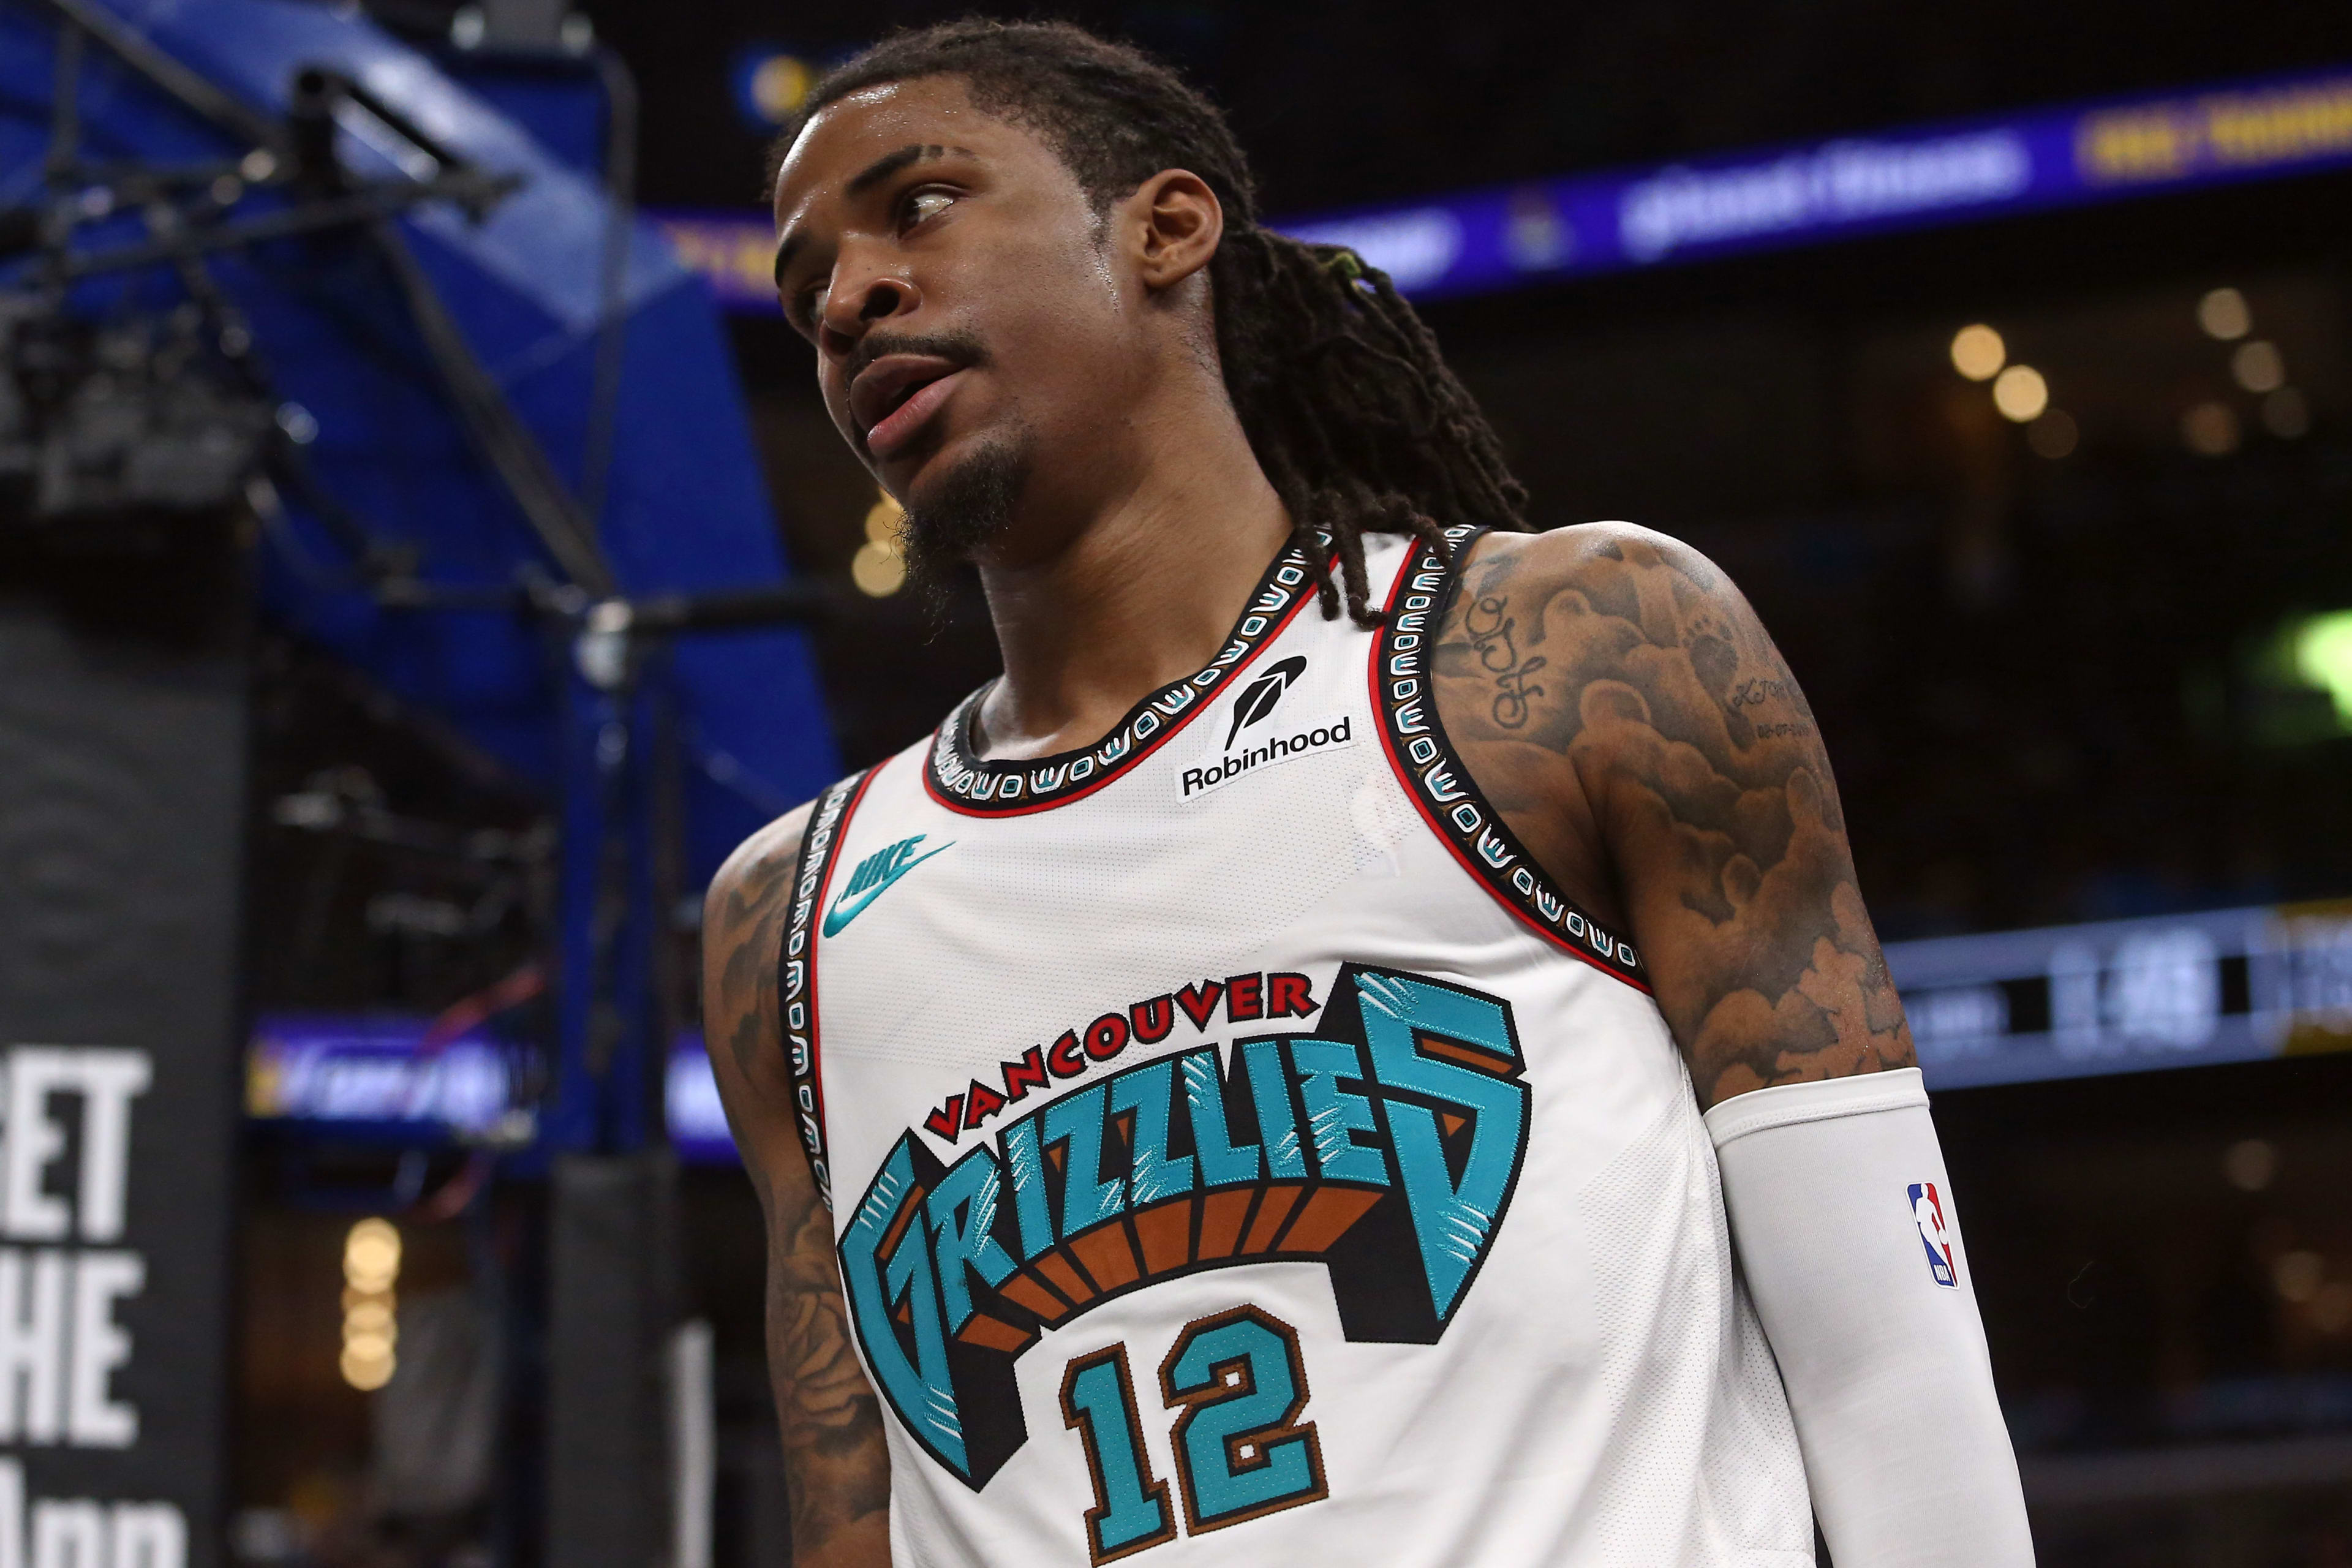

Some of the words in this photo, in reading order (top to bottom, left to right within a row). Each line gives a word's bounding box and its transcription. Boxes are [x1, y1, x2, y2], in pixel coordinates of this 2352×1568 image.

[1182, 716, 1351, 796] Robinhood
[839, 834, 927, 903] NIKE
[0, 1044, 154, 1245] ET
[924, 972, 1321, 1145] VANCOUVER
[837, 962, 1532, 1493] GRIZZLIES
[1933, 1264, 1951, 1282] NBA
[1058, 1302, 1330, 1567] 12
